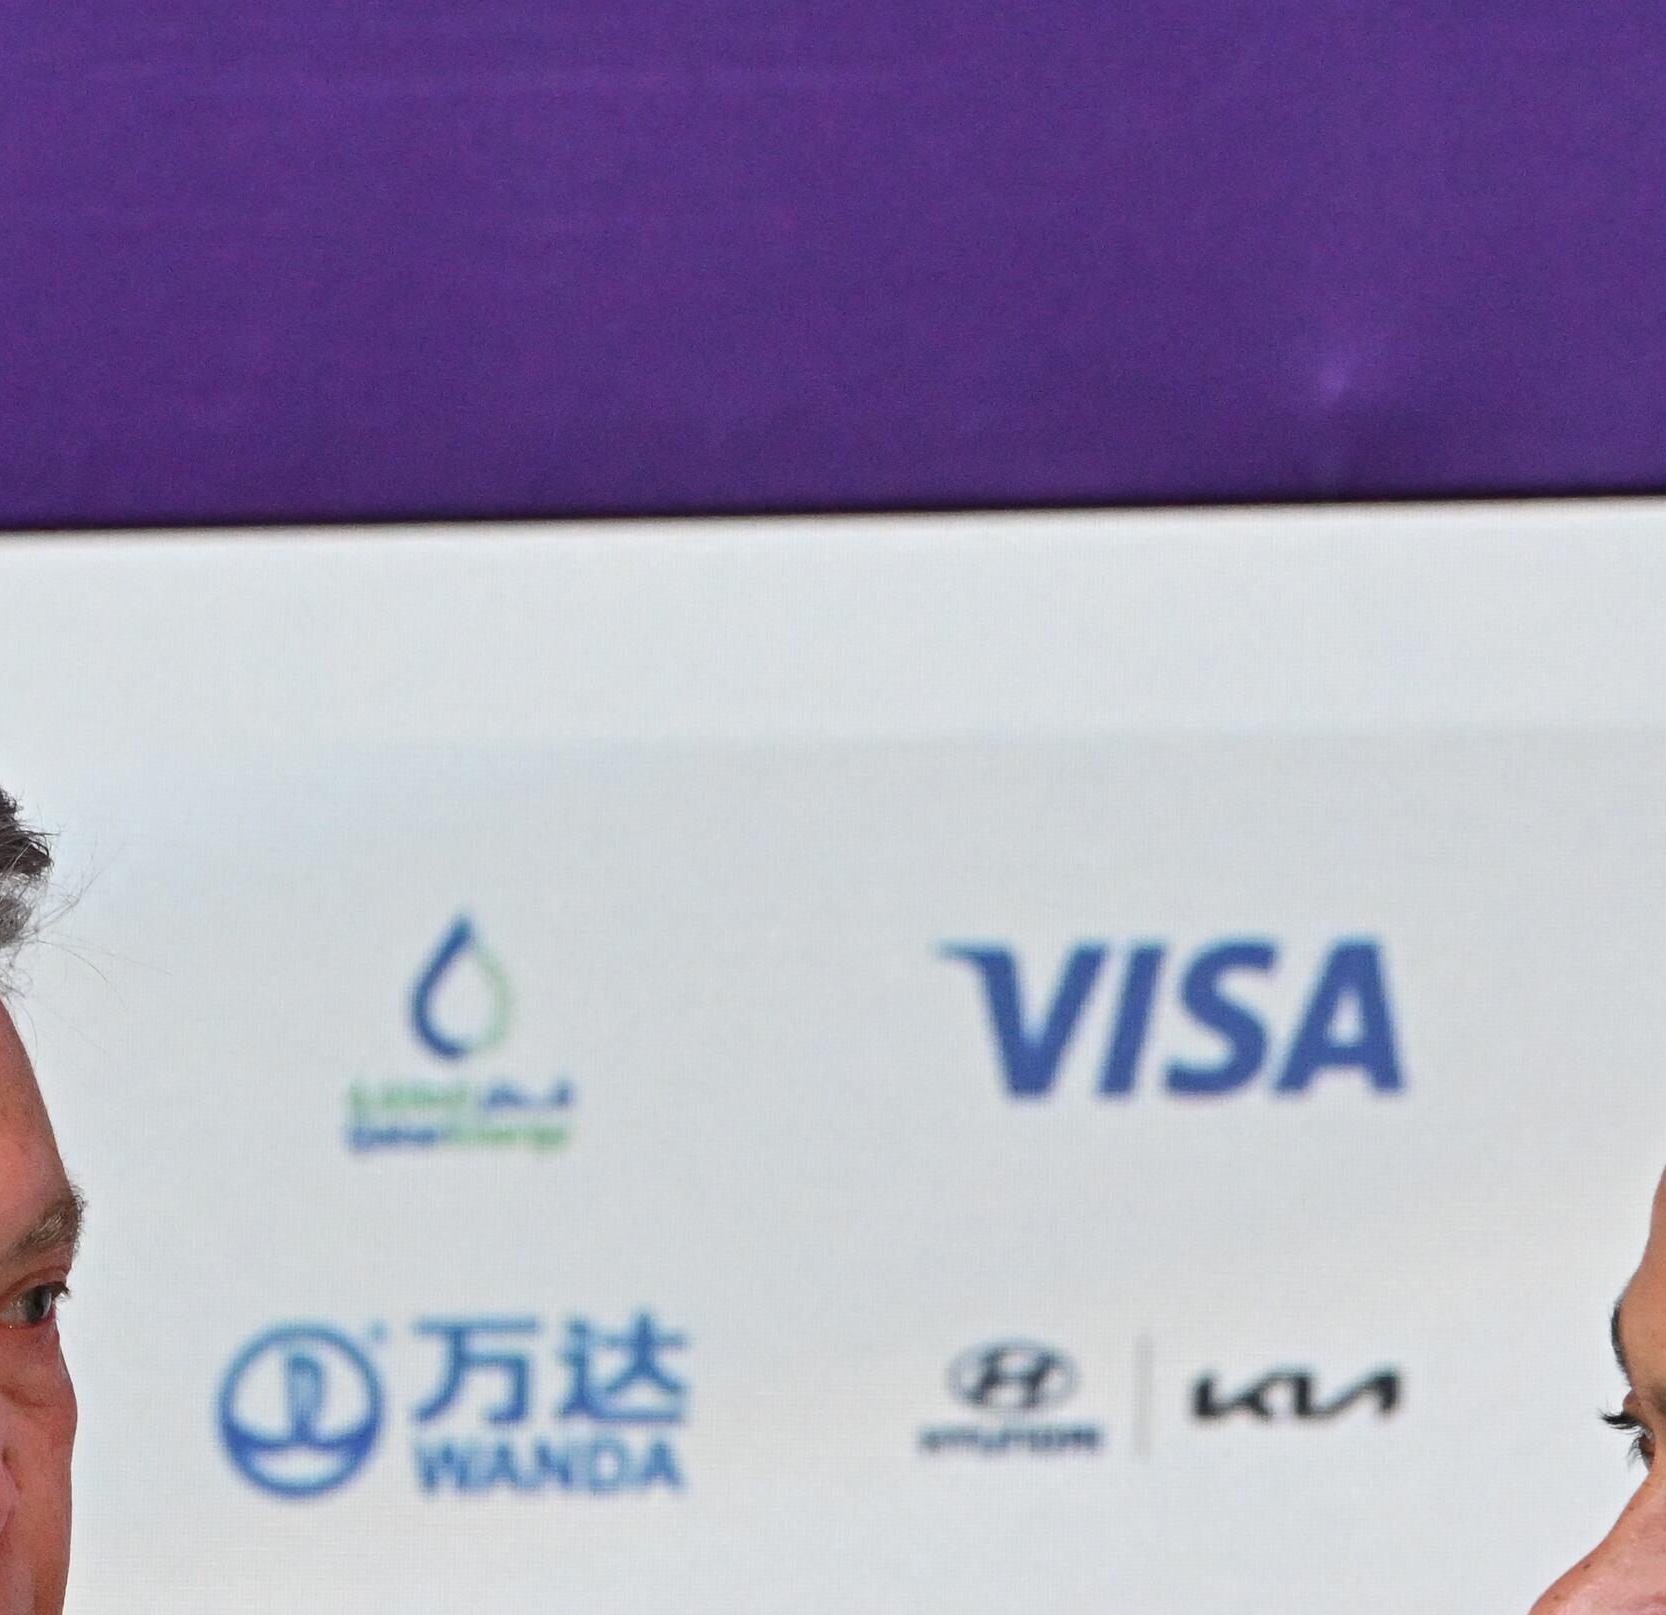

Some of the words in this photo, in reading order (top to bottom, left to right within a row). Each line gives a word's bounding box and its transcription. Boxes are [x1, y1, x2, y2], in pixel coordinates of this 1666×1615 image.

[938, 933, 1406, 1100] VISA
[413, 1307, 689, 1426] 万达
[415, 1436, 687, 1495] WANDA
